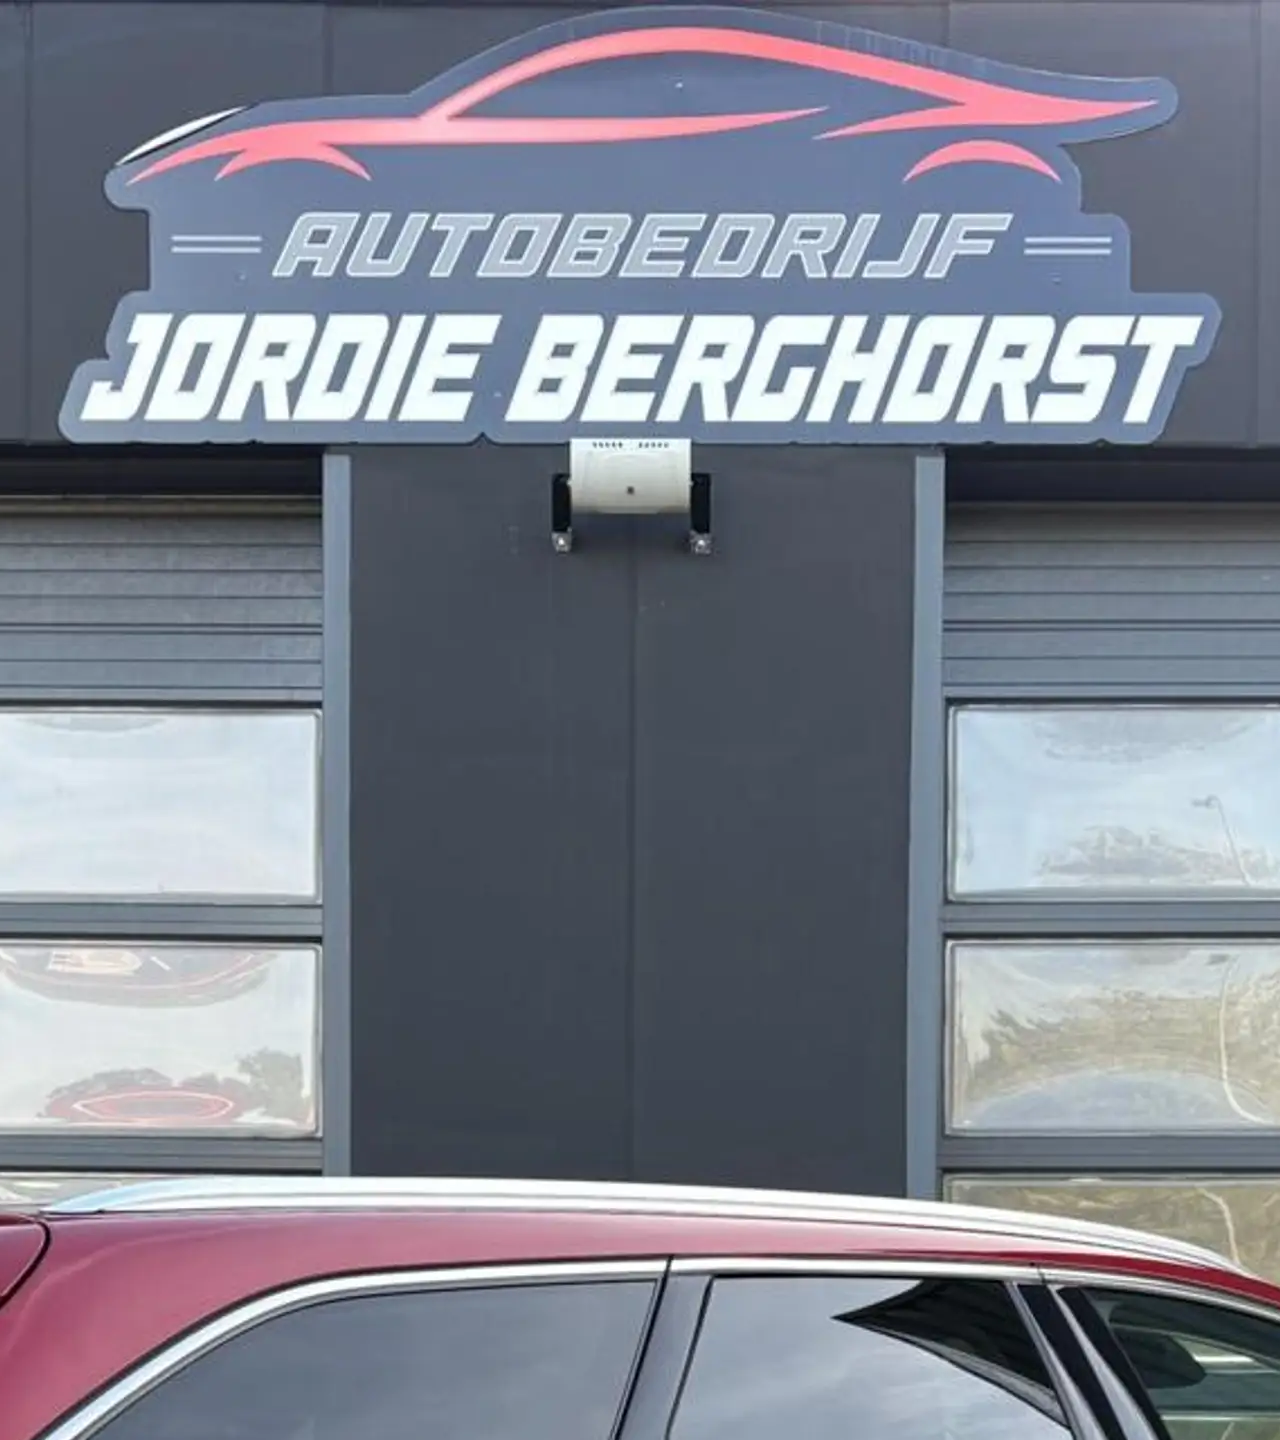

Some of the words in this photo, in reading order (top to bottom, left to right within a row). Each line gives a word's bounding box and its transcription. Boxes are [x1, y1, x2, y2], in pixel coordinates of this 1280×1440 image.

[271, 211, 1014, 280] AUTOBEDRIJF
[79, 313, 502, 423] JORDIE
[505, 313, 1205, 423] BERGHORST
